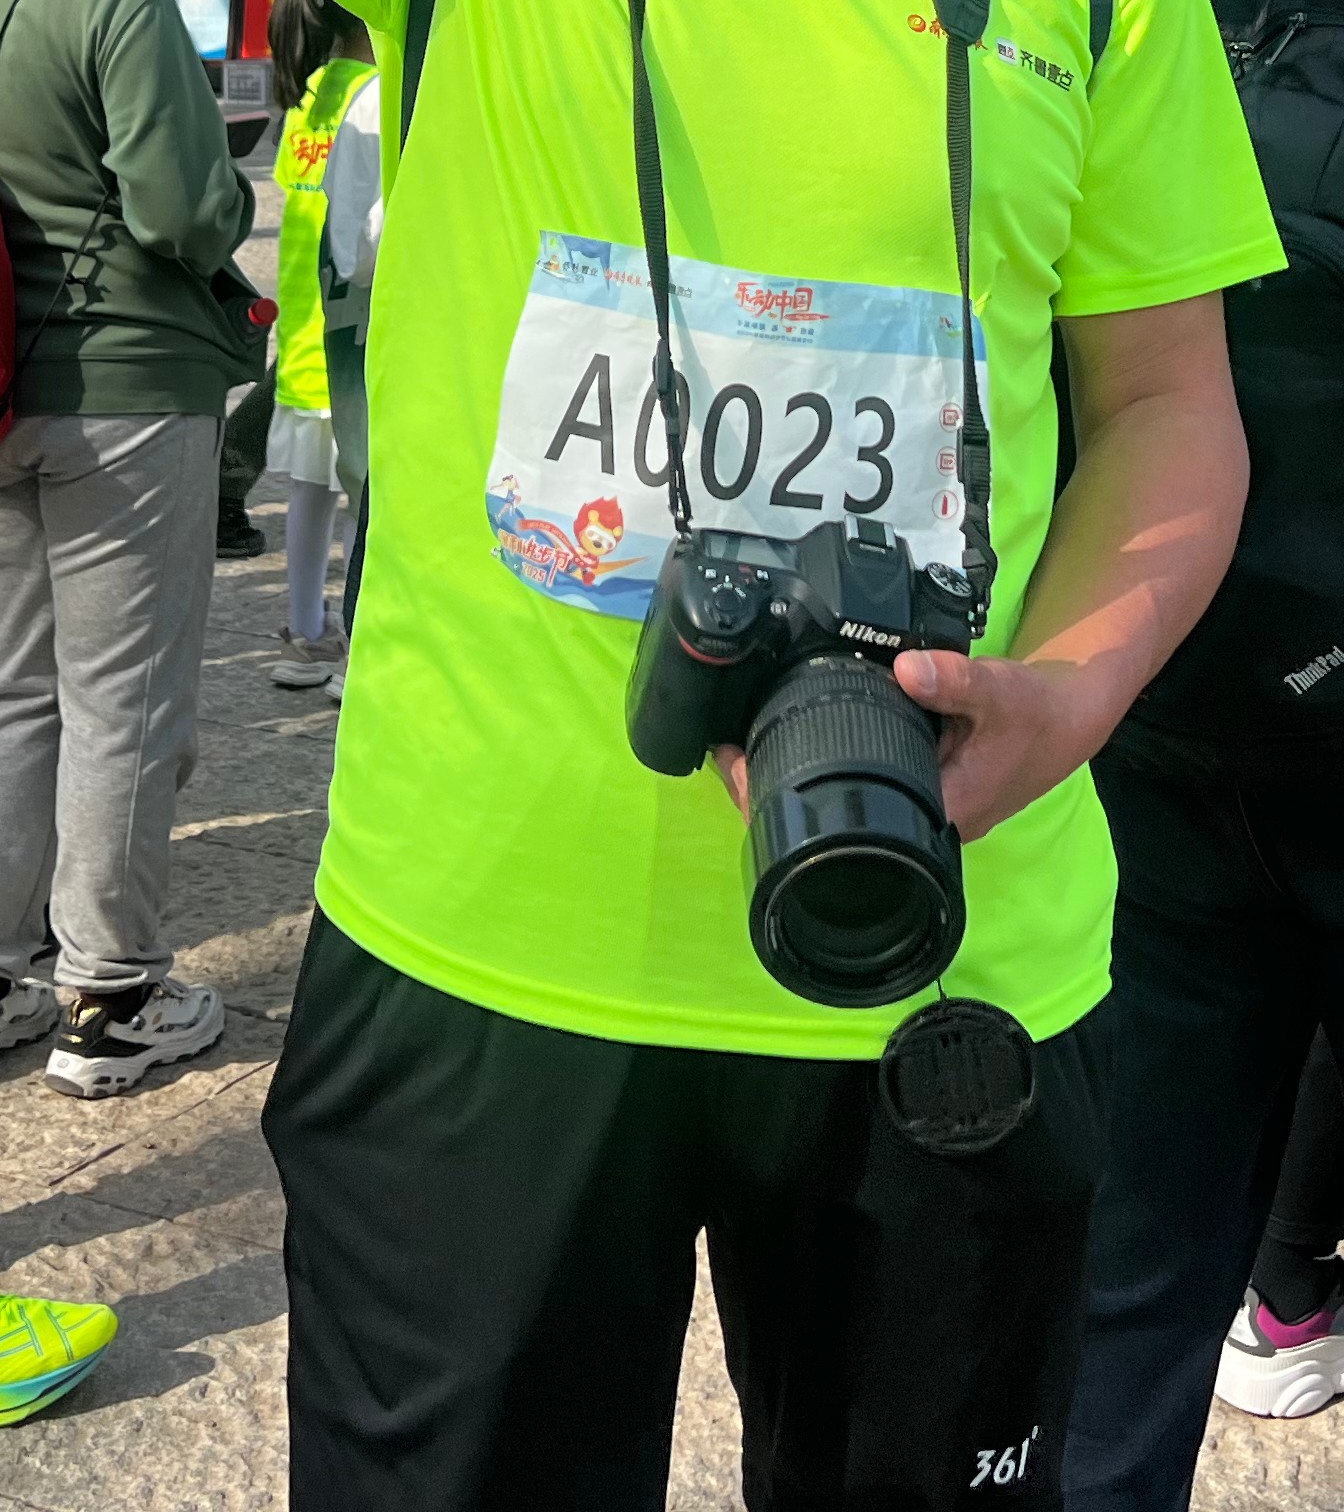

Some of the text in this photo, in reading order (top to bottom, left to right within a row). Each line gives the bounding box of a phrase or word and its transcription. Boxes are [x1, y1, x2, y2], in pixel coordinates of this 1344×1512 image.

[1020, 49, 1075, 92] 齐鲁壹点
[544, 352, 896, 514] A0023
[839, 620, 903, 648] Nikon
